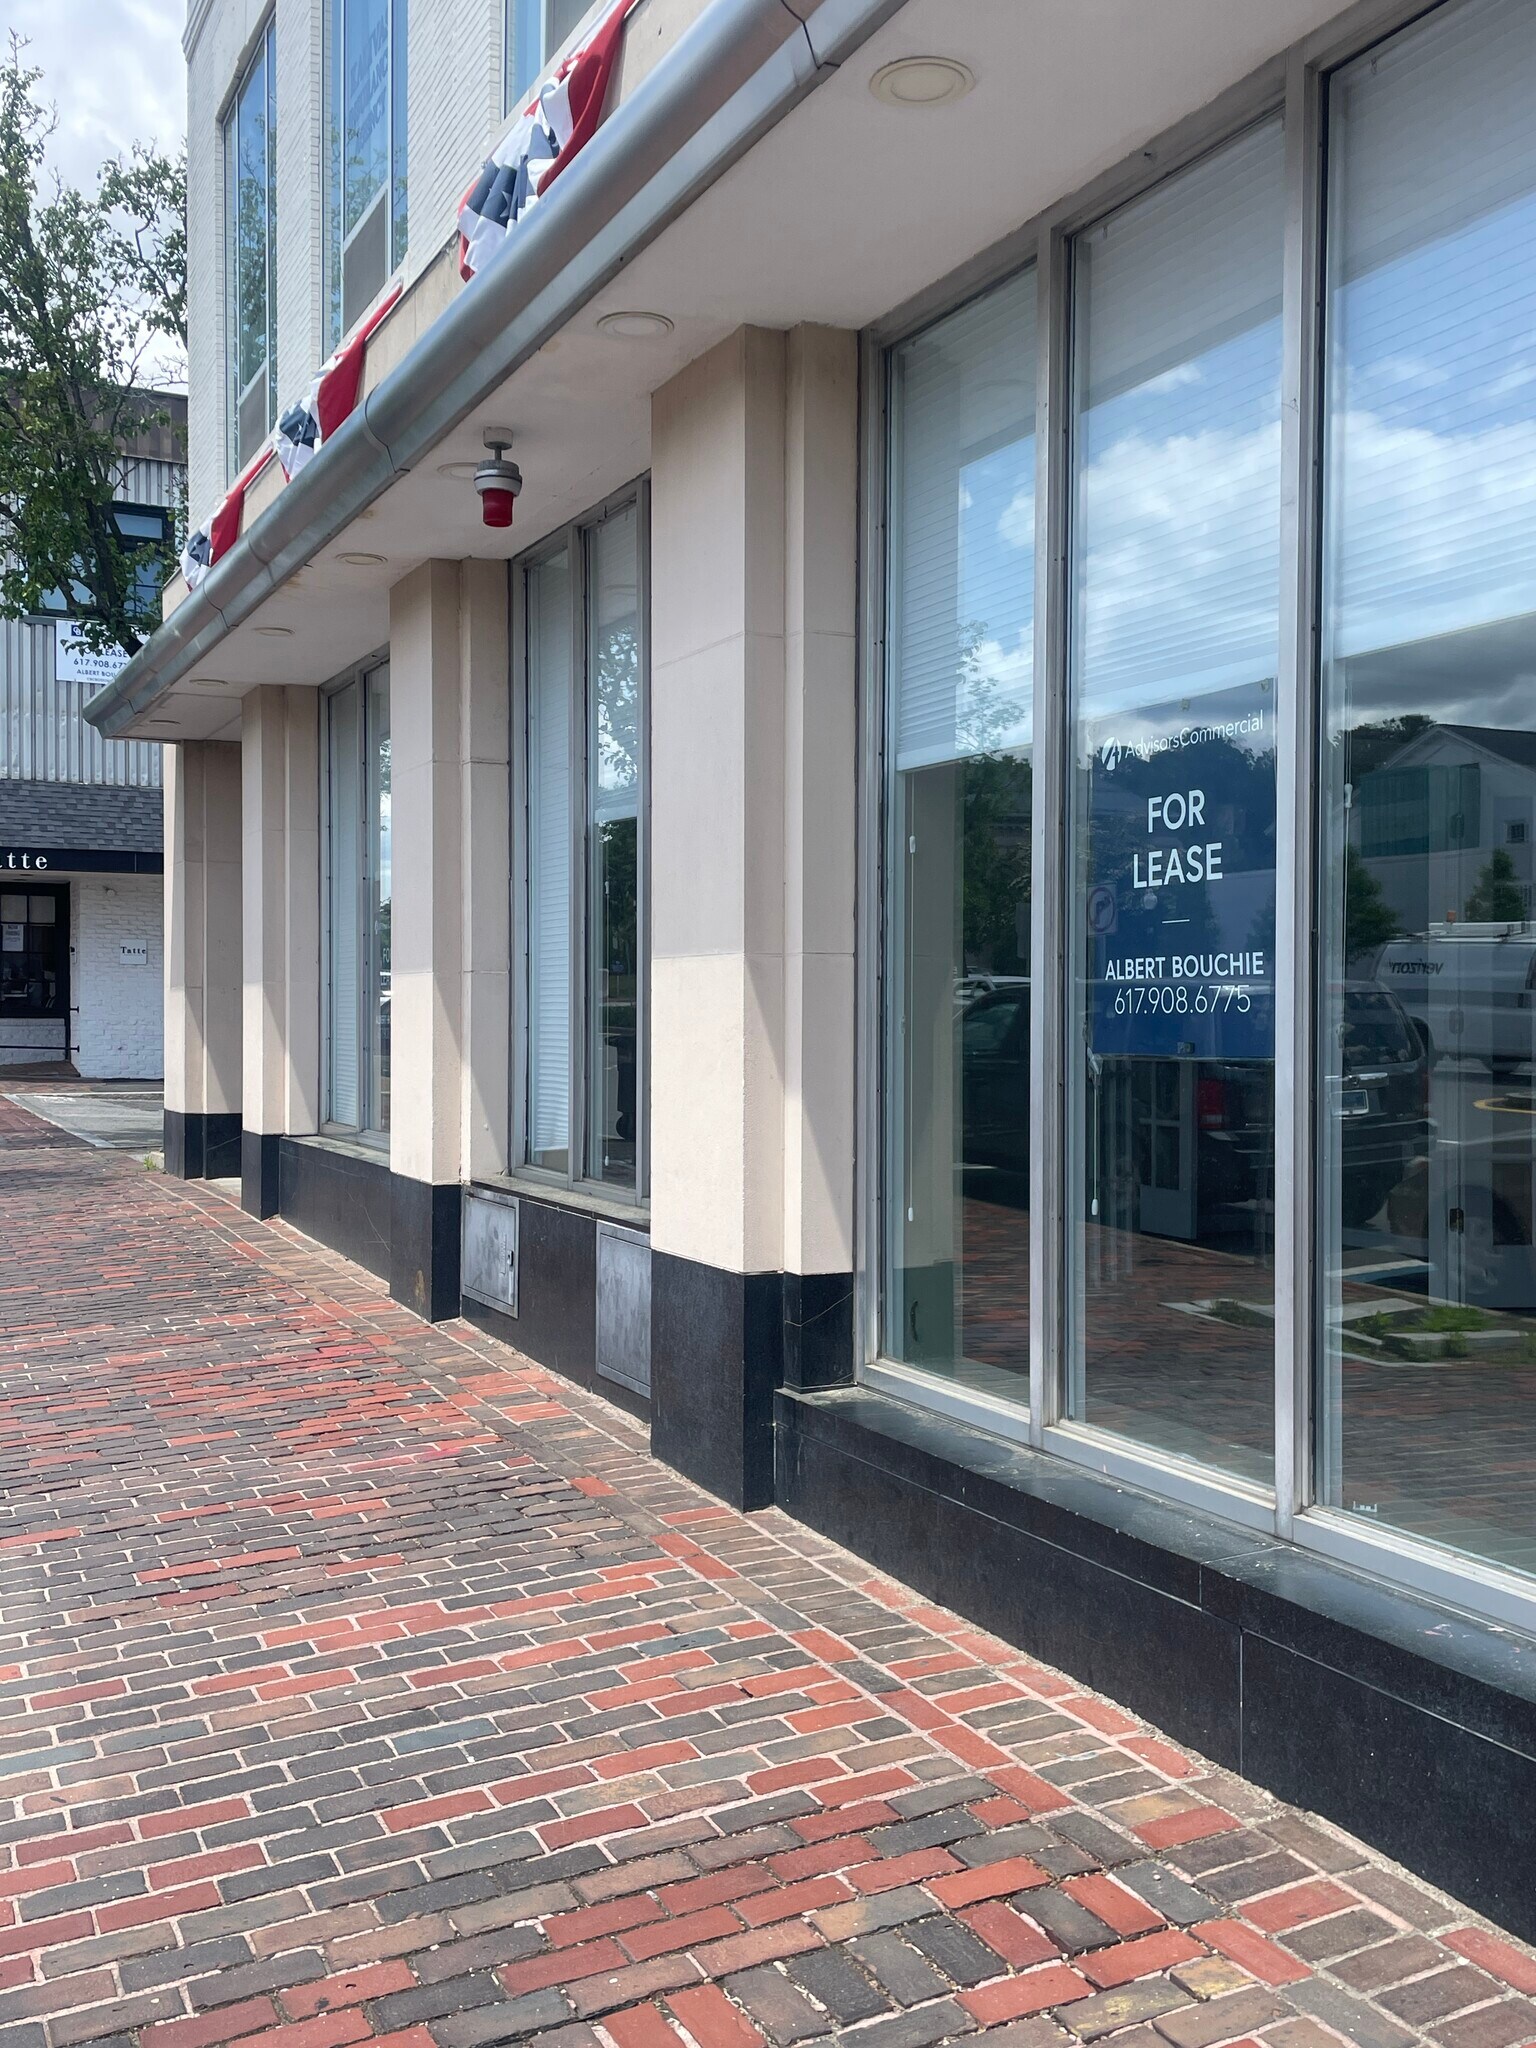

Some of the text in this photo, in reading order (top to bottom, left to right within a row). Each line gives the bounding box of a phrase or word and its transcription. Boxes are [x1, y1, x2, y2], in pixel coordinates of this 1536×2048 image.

[73, 658, 127, 670] 617.908.67
[76, 669, 100, 677] ALBERT
[1125, 709, 1264, 759] AdvisorsCommercial
[1147, 789, 1206, 834] FOR
[0, 852, 48, 870] tte
[1132, 842, 1224, 889] LEASE
[120, 946, 147, 955] Tatte
[1105, 951, 1264, 981] ALBERT BOUCHIE
[1114, 984, 1251, 1015] 617.908.6775
